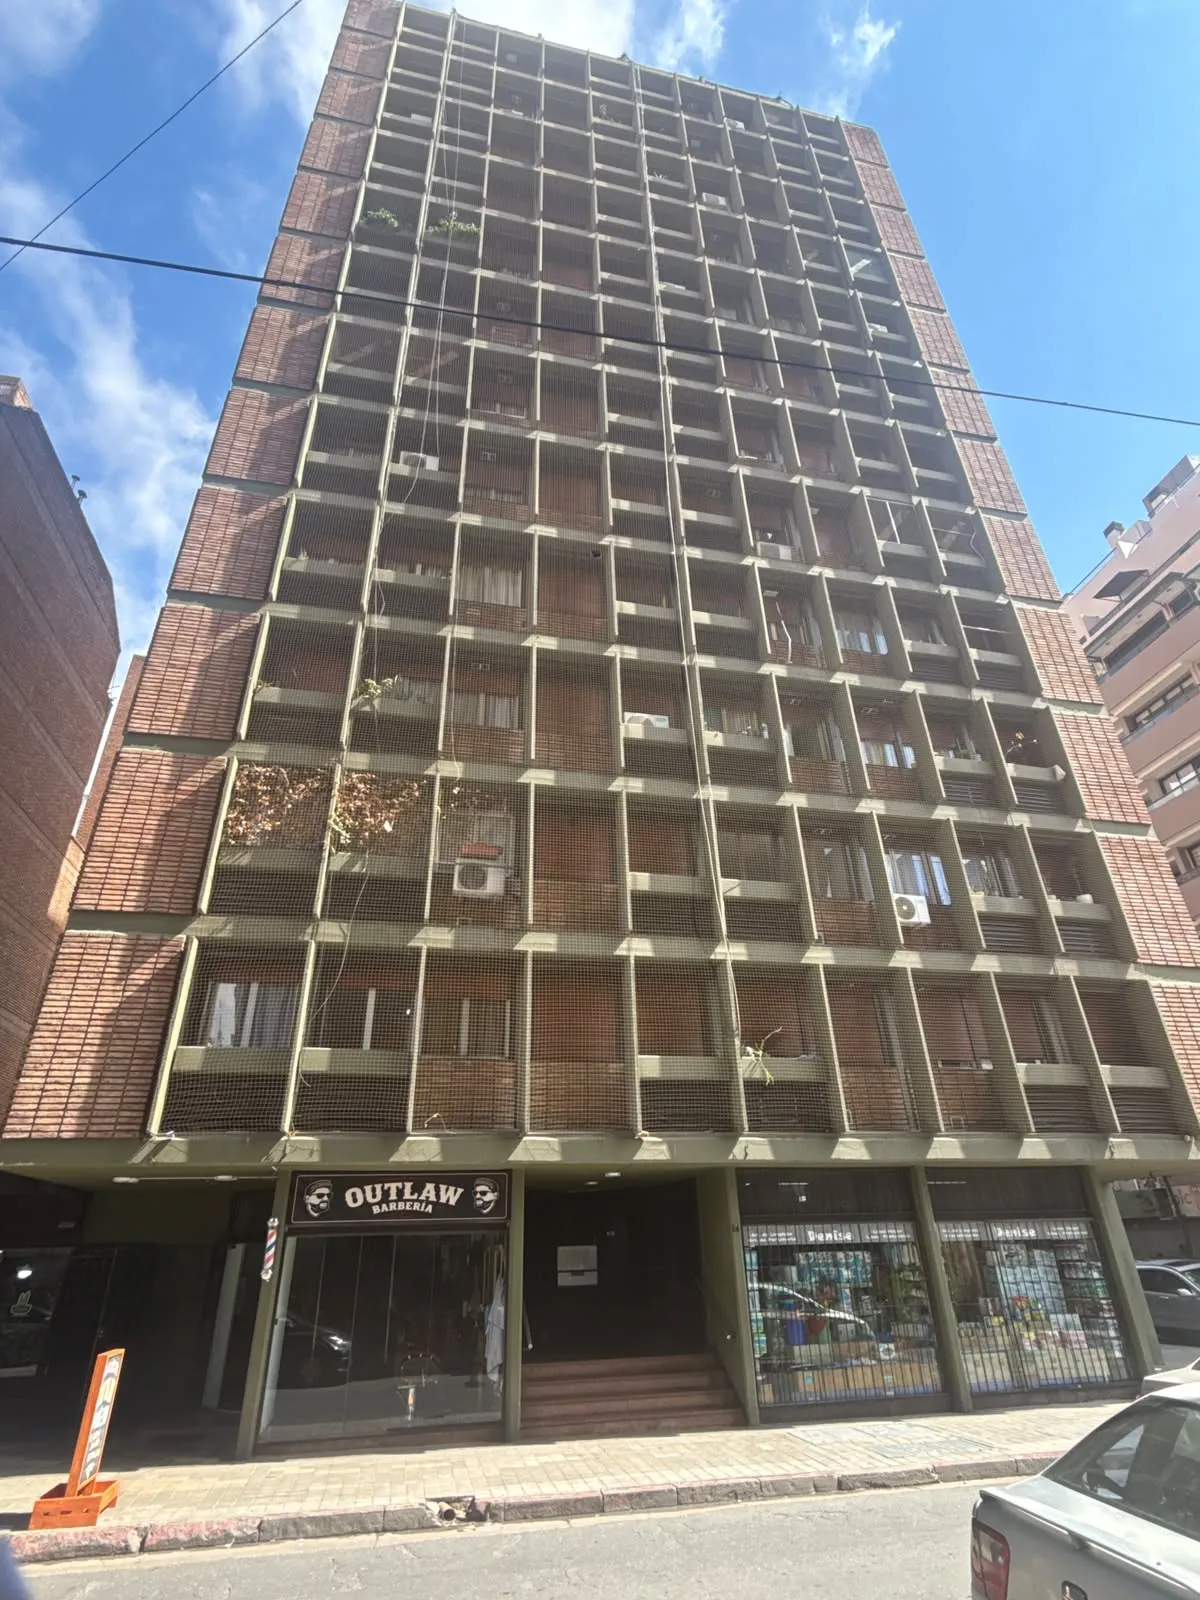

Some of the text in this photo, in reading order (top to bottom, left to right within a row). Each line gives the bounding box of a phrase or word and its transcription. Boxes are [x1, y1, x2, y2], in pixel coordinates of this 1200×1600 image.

[344, 1181, 464, 1208] OUTLAW
[372, 1200, 433, 1215] BARBERÍA
[807, 1230, 854, 1242] Denise
[993, 1226, 1037, 1238] Denise
